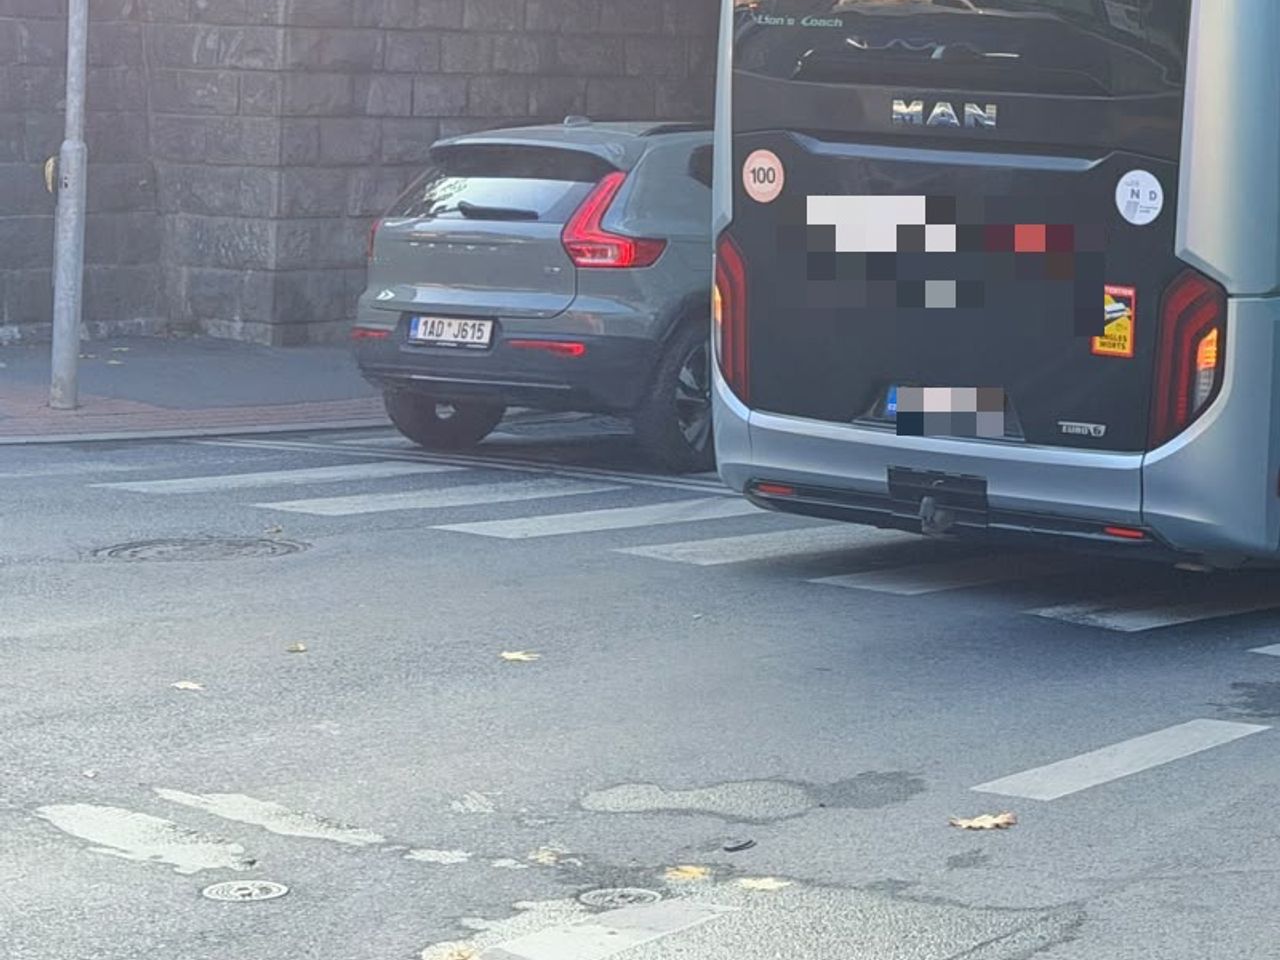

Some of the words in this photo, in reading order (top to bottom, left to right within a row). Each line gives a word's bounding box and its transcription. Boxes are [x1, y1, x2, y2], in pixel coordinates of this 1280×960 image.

[800, 14, 843, 28] Coach
[891, 99, 998, 129] MAN
[750, 166, 776, 184] 100
[422, 320, 445, 338] 1AD
[453, 322, 486, 341] J615
